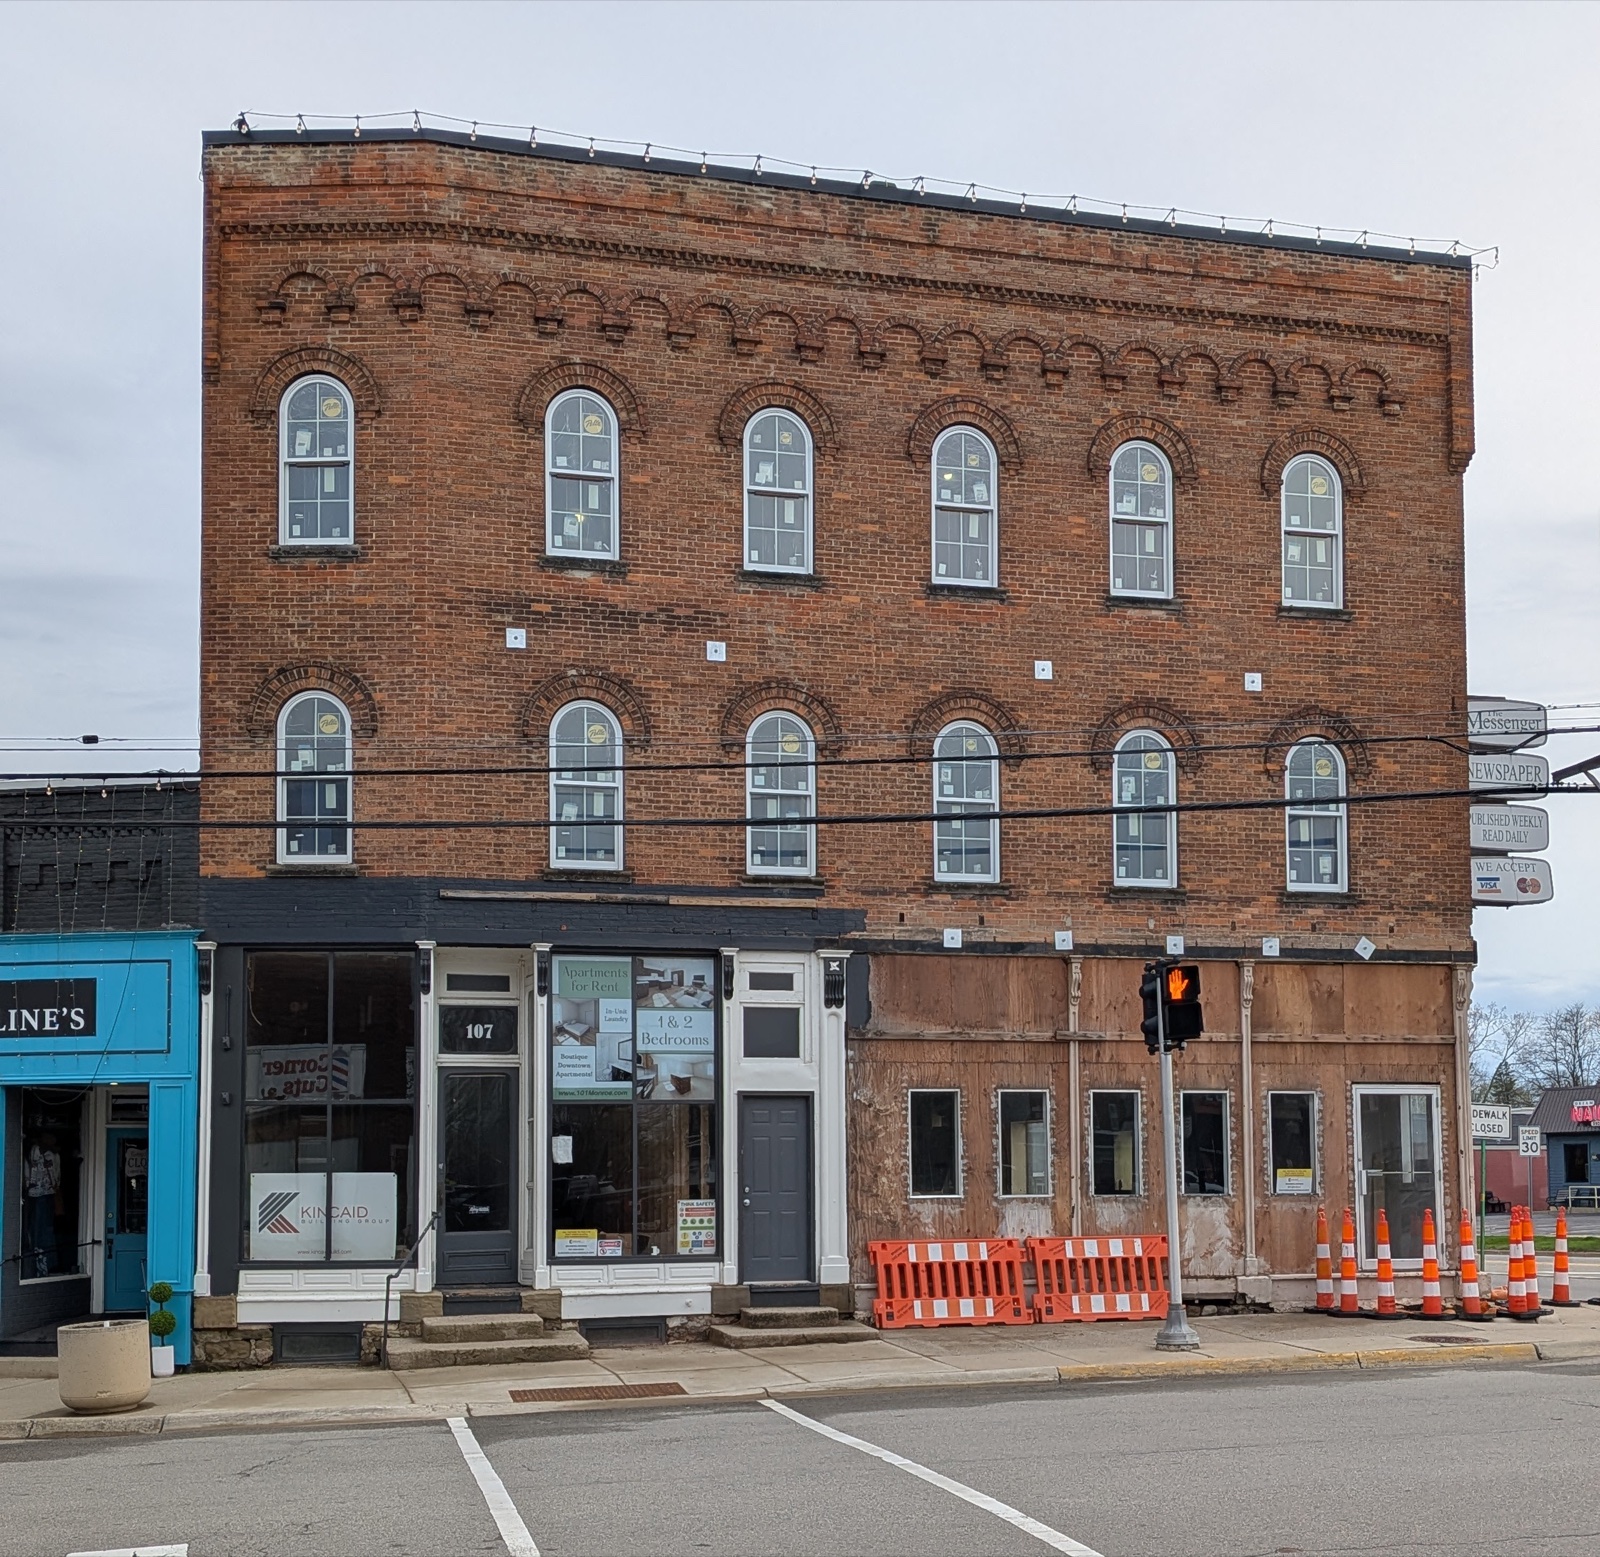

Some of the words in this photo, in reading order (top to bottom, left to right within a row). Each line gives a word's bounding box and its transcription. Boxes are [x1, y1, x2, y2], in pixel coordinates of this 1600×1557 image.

[1468, 711, 1542, 731] Messenger
[1470, 812, 1511, 827] UBLISHED
[1512, 814, 1544, 828] WEEKLY
[1482, 829, 1504, 842] READ
[1505, 830, 1529, 843] DAILY
[1475, 861, 1493, 872] WE
[1496, 862, 1537, 873] ACCEPT
[1480, 881, 1498, 889] VISA
[563, 966, 629, 980] Apartments
[571, 980, 589, 992] for
[591, 980, 619, 992] Rent
[604, 1016, 629, 1024] Laundry
[658, 1015, 663, 1028] 1
[667, 1015, 680, 1029] &
[683, 1015, 693, 1029] 2
[465, 1023, 494, 1039] 107
[641, 1032, 710, 1046] Bedrooms
[560, 1053, 588, 1061] Boutique
[555, 1071, 593, 1079] Apartments!
[1521, 1142, 1539, 1153] 30
